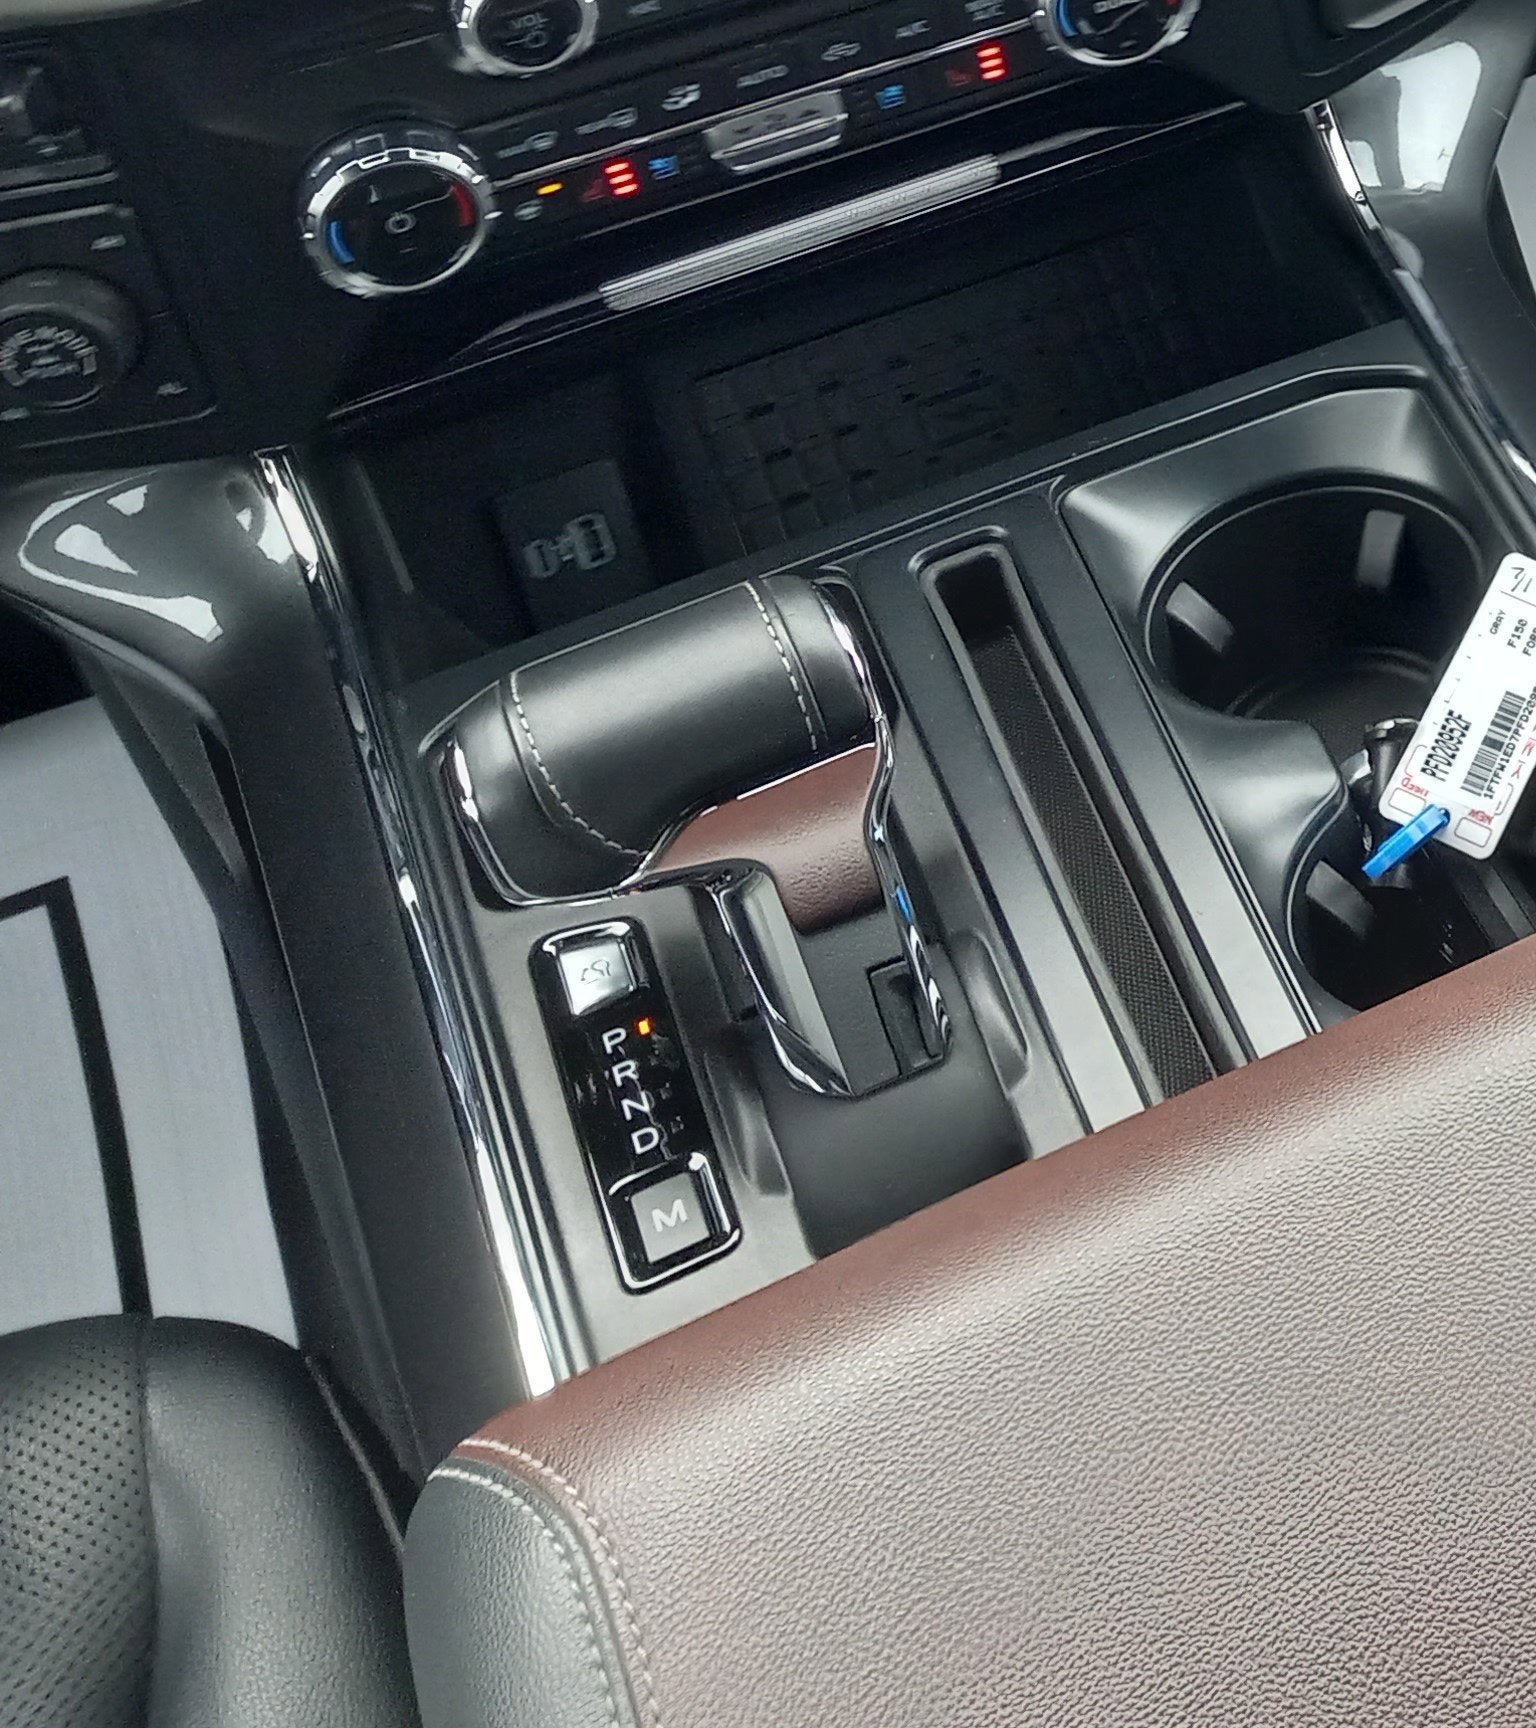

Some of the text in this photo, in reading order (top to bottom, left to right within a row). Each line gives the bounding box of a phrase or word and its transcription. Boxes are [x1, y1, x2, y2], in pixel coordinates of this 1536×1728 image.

[1489, 608, 1507, 636] GRAY
[1506, 618, 1529, 649] F150
[601, 1027, 628, 1055] P
[611, 1059, 640, 1088] R
[620, 1090, 651, 1122] N
[629, 1127, 661, 1155] D
[651, 1198, 688, 1232] M
